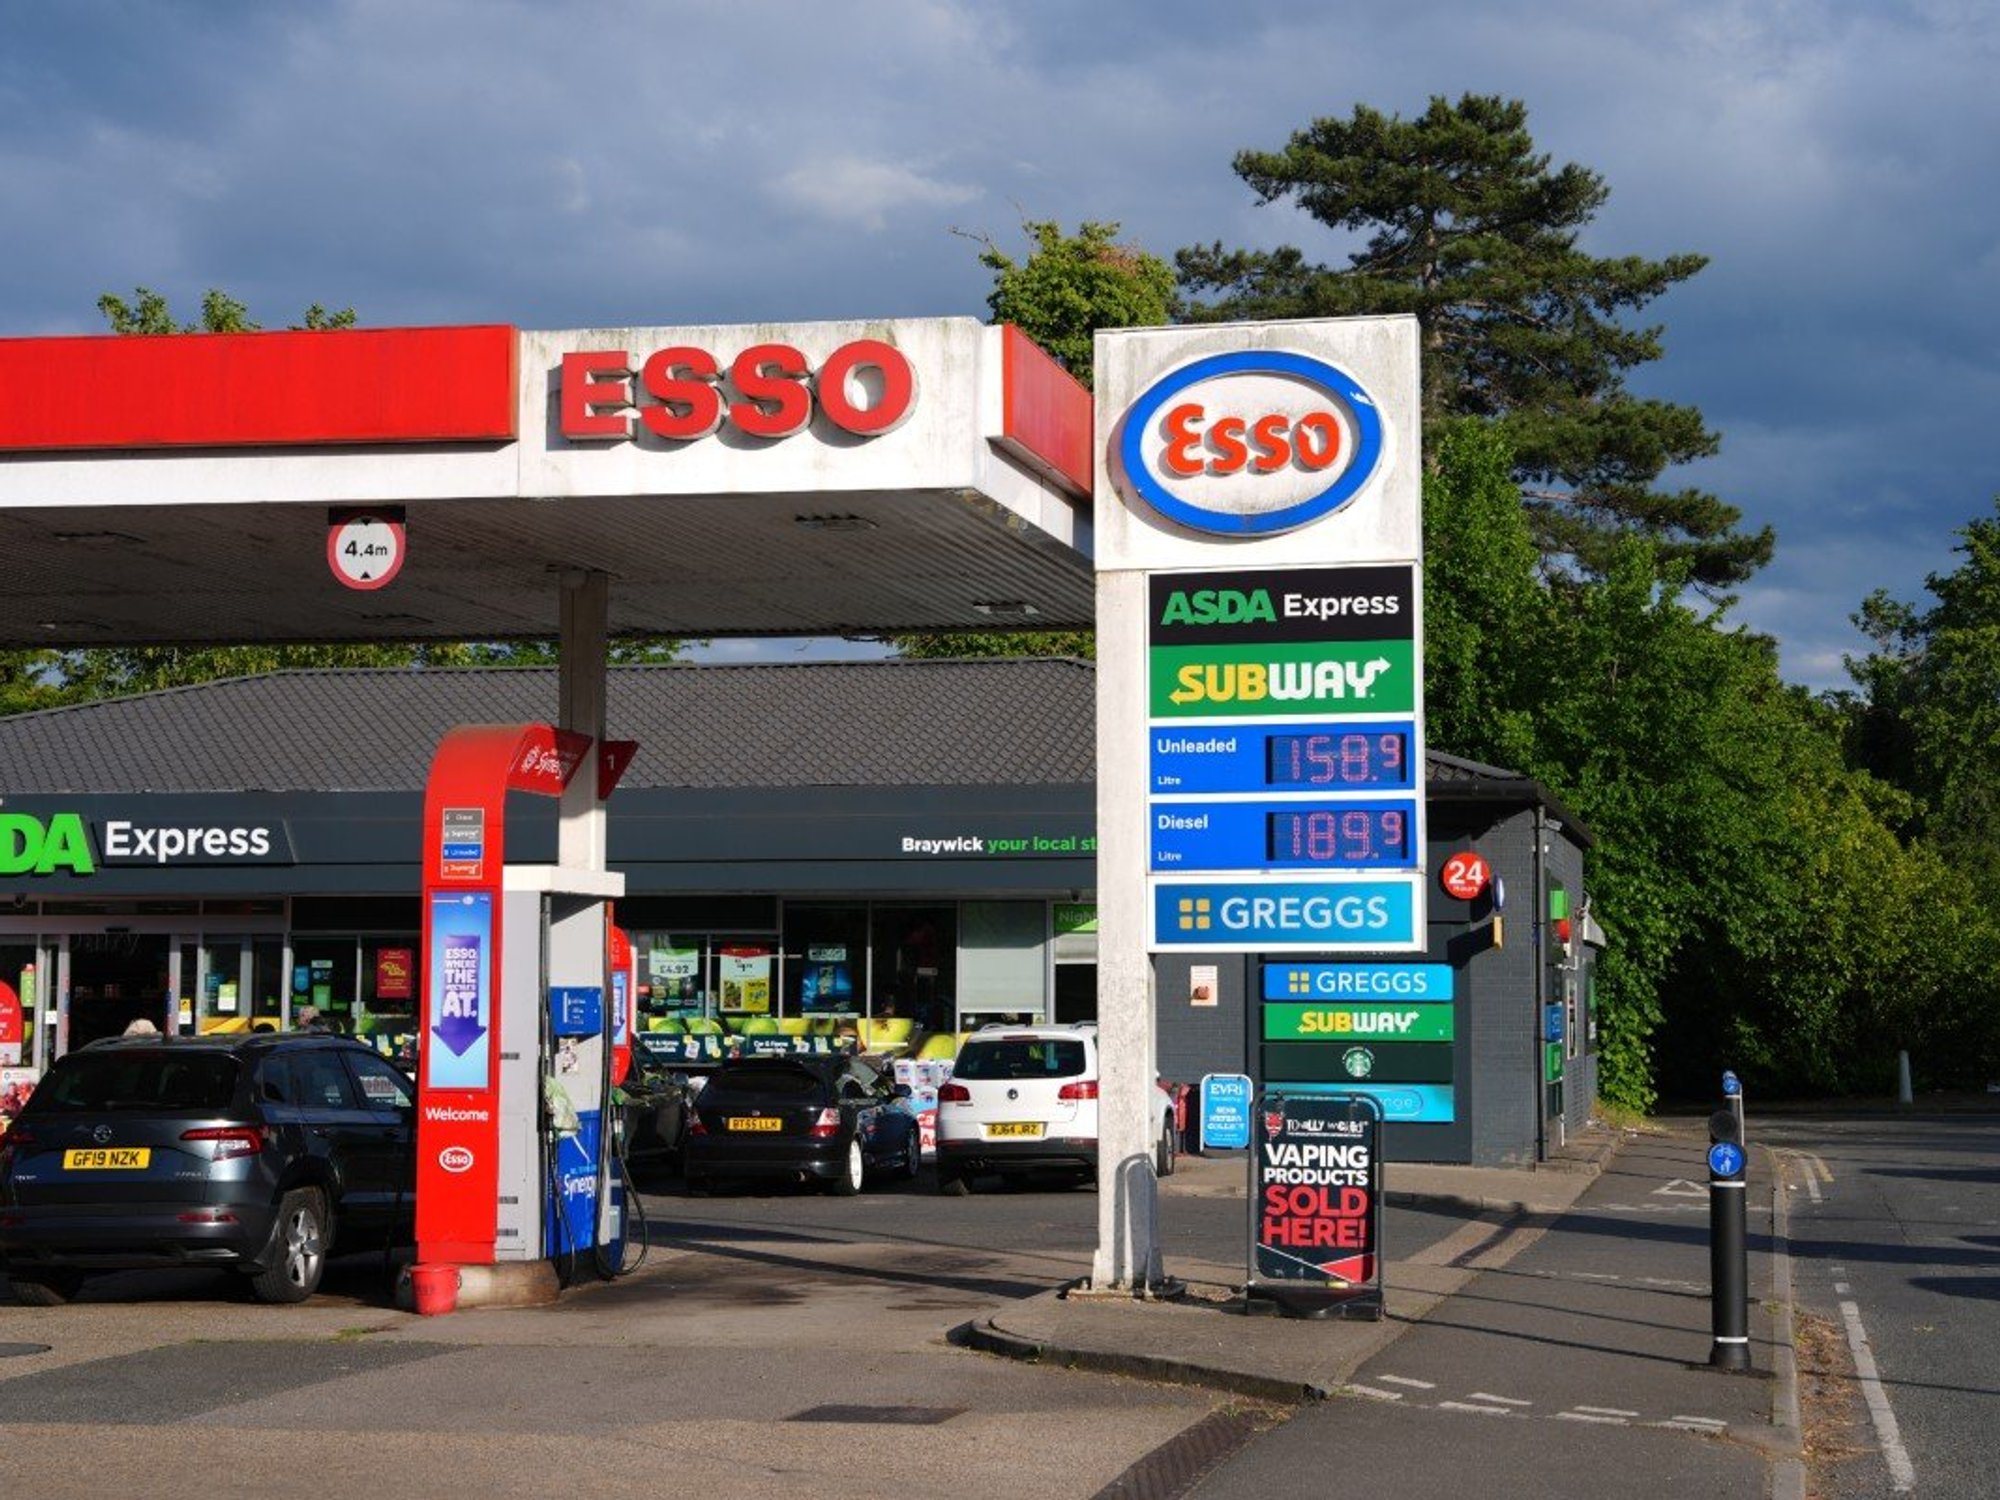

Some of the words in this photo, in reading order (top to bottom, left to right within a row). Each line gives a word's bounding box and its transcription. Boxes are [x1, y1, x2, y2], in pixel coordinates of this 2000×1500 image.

[561, 340, 915, 440] ESSO
[1166, 403, 1340, 475] Esso
[345, 541, 388, 556] 4.4m
[1161, 589, 1277, 625] ASDA
[1284, 593, 1399, 621] Express
[1169, 657, 1391, 705] SUBWAY
[1157, 738, 1237, 753] Unleaded
[1157, 776, 1181, 785] Litre
[1158, 815, 1209, 829] Diesel
[106, 821, 270, 863] Express
[902, 837, 983, 853] Braywick
[988, 840, 1028, 853] your
[1034, 836, 1075, 850] local
[1158, 852, 1182, 862] Litre
[1449, 861, 1483, 885] 24
[1220, 896, 1388, 929] GREGGS
[445, 970, 477, 983] THE
[1317, 971, 1427, 993] GREGGS
[443, 992, 477, 1018] AT.
[1298, 1011, 1420, 1034] SUBWAY
[426, 1108, 488, 1121] Welcome
[73, 1152, 105, 1166] GF19
[111, 1151, 140, 1166] NZK
[444, 1153, 468, 1164] Esso
[1265, 1144, 1369, 1168] VAPING
[1264, 1168, 1369, 1186] PRODUCTS
[1265, 1185, 1368, 1217] SOLD
[1263, 1217, 1366, 1247] HERE!
